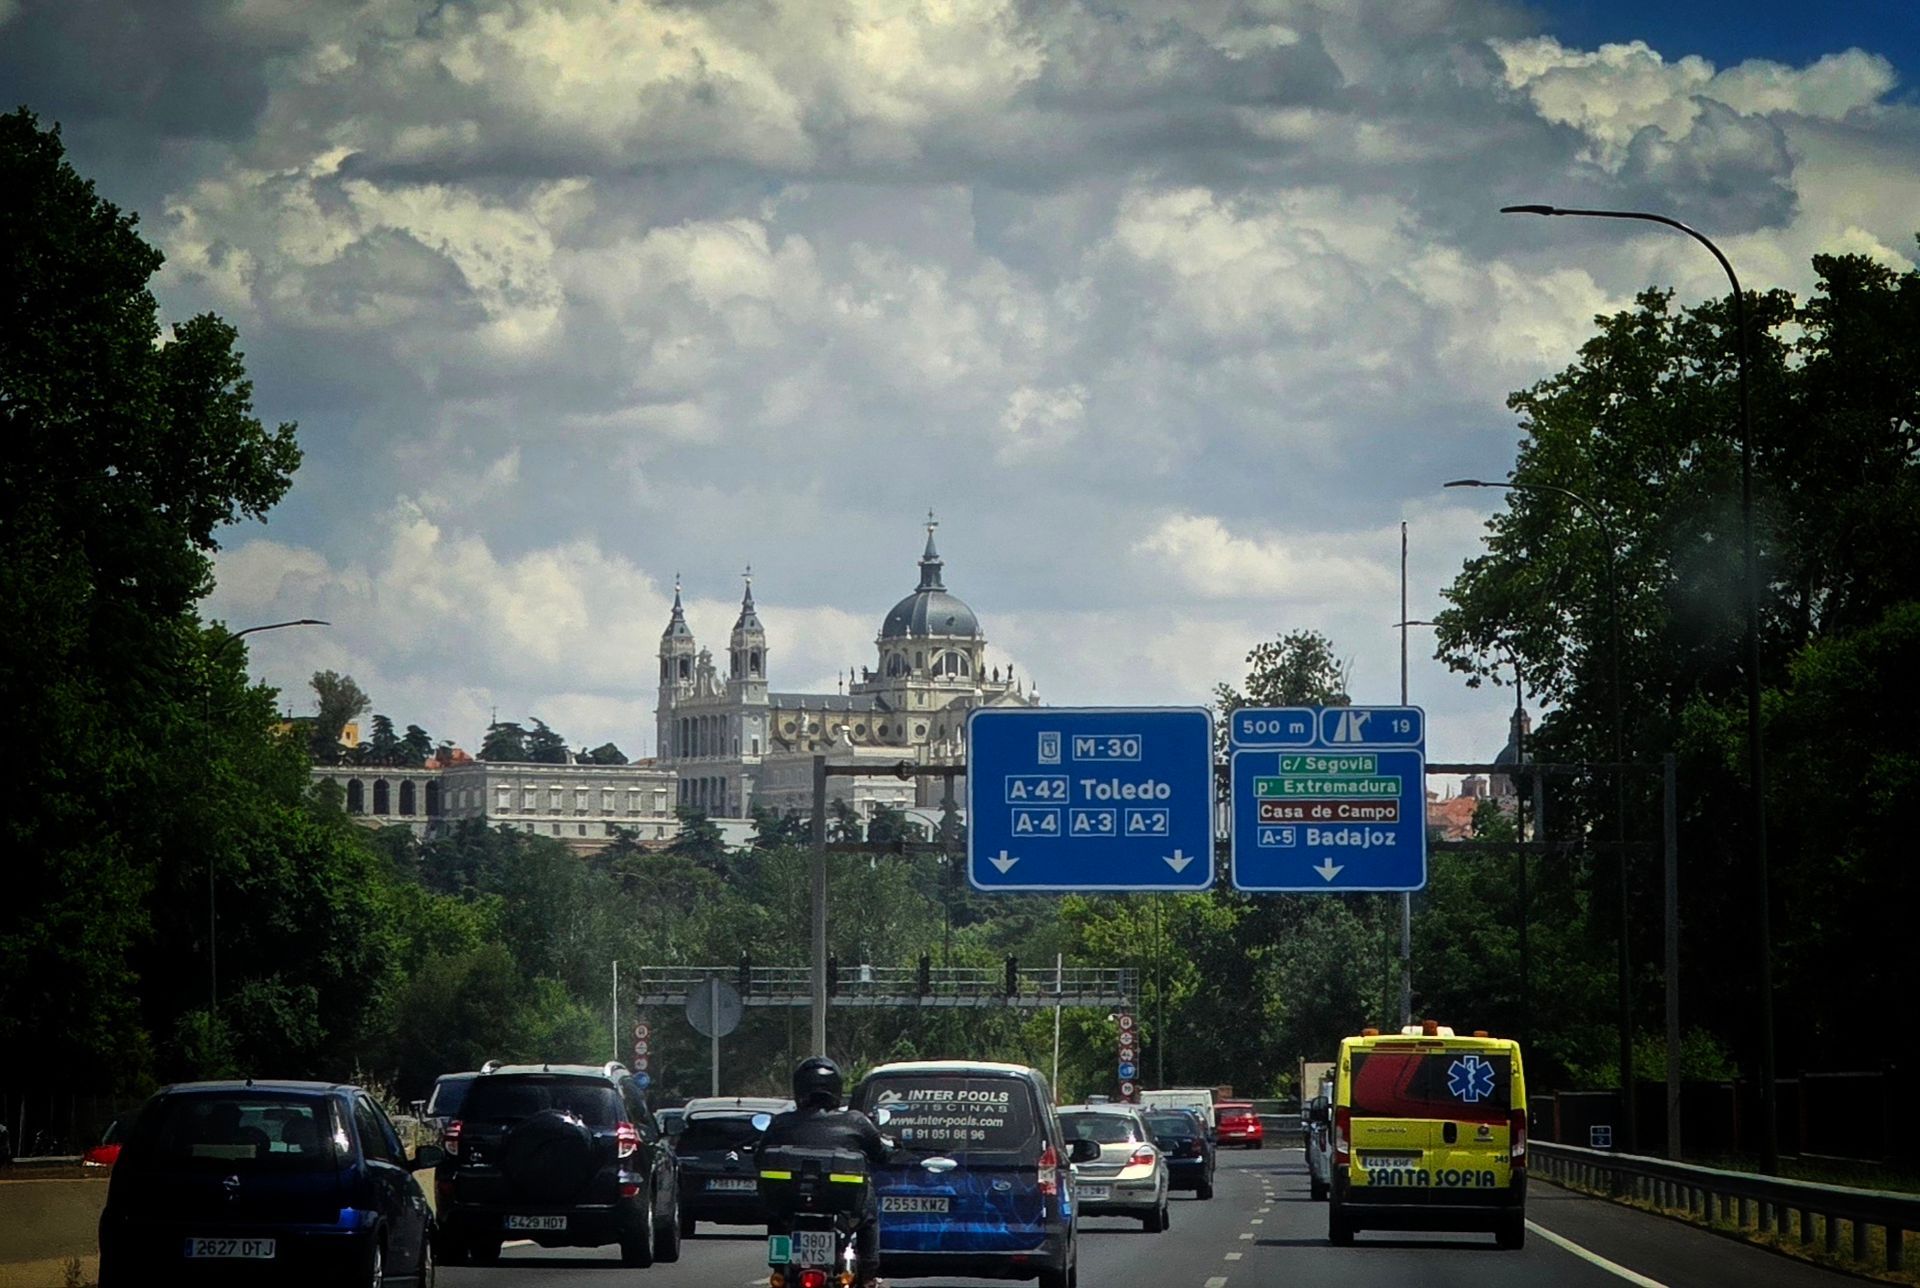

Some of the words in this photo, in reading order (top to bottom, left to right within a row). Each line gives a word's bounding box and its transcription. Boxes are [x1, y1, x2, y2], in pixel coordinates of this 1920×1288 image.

[1243, 720, 1280, 734] 500
[1289, 722, 1304, 734] m
[1392, 719, 1410, 733] 19
[1075, 739, 1138, 757] M-30
[1282, 757, 1300, 771] c/
[1305, 757, 1373, 775] Segovia
[1010, 780, 1066, 799] A-42
[1080, 778, 1171, 800] Toledo
[1284, 779, 1397, 793] Extremadura
[1260, 804, 1303, 818] Casa
[1311, 804, 1332, 818] de
[1338, 804, 1396, 821] Campo
[1016, 812, 1057, 832] A-4
[1073, 812, 1113, 832] A-3
[1129, 812, 1165, 832] A-2
[1262, 830, 1293, 844] A-5
[1306, 827, 1396, 849] Badajoz
[908, 1090, 954, 1101] INTER
[957, 1091, 1009, 1103] POOLS
[910, 1103, 1008, 1114] PISCINAS
[917, 1129, 929, 1140] 91
[970, 1129, 985, 1141] 96
[1367, 1168, 1430, 1187] SANTA
[1435, 1168, 1496, 1187] SOFIA
[884, 1198, 918, 1211] 2553
[197, 1240, 238, 1256] 2627
[771, 1237, 787, 1260] L
[802, 1234, 833, 1249] 3801
